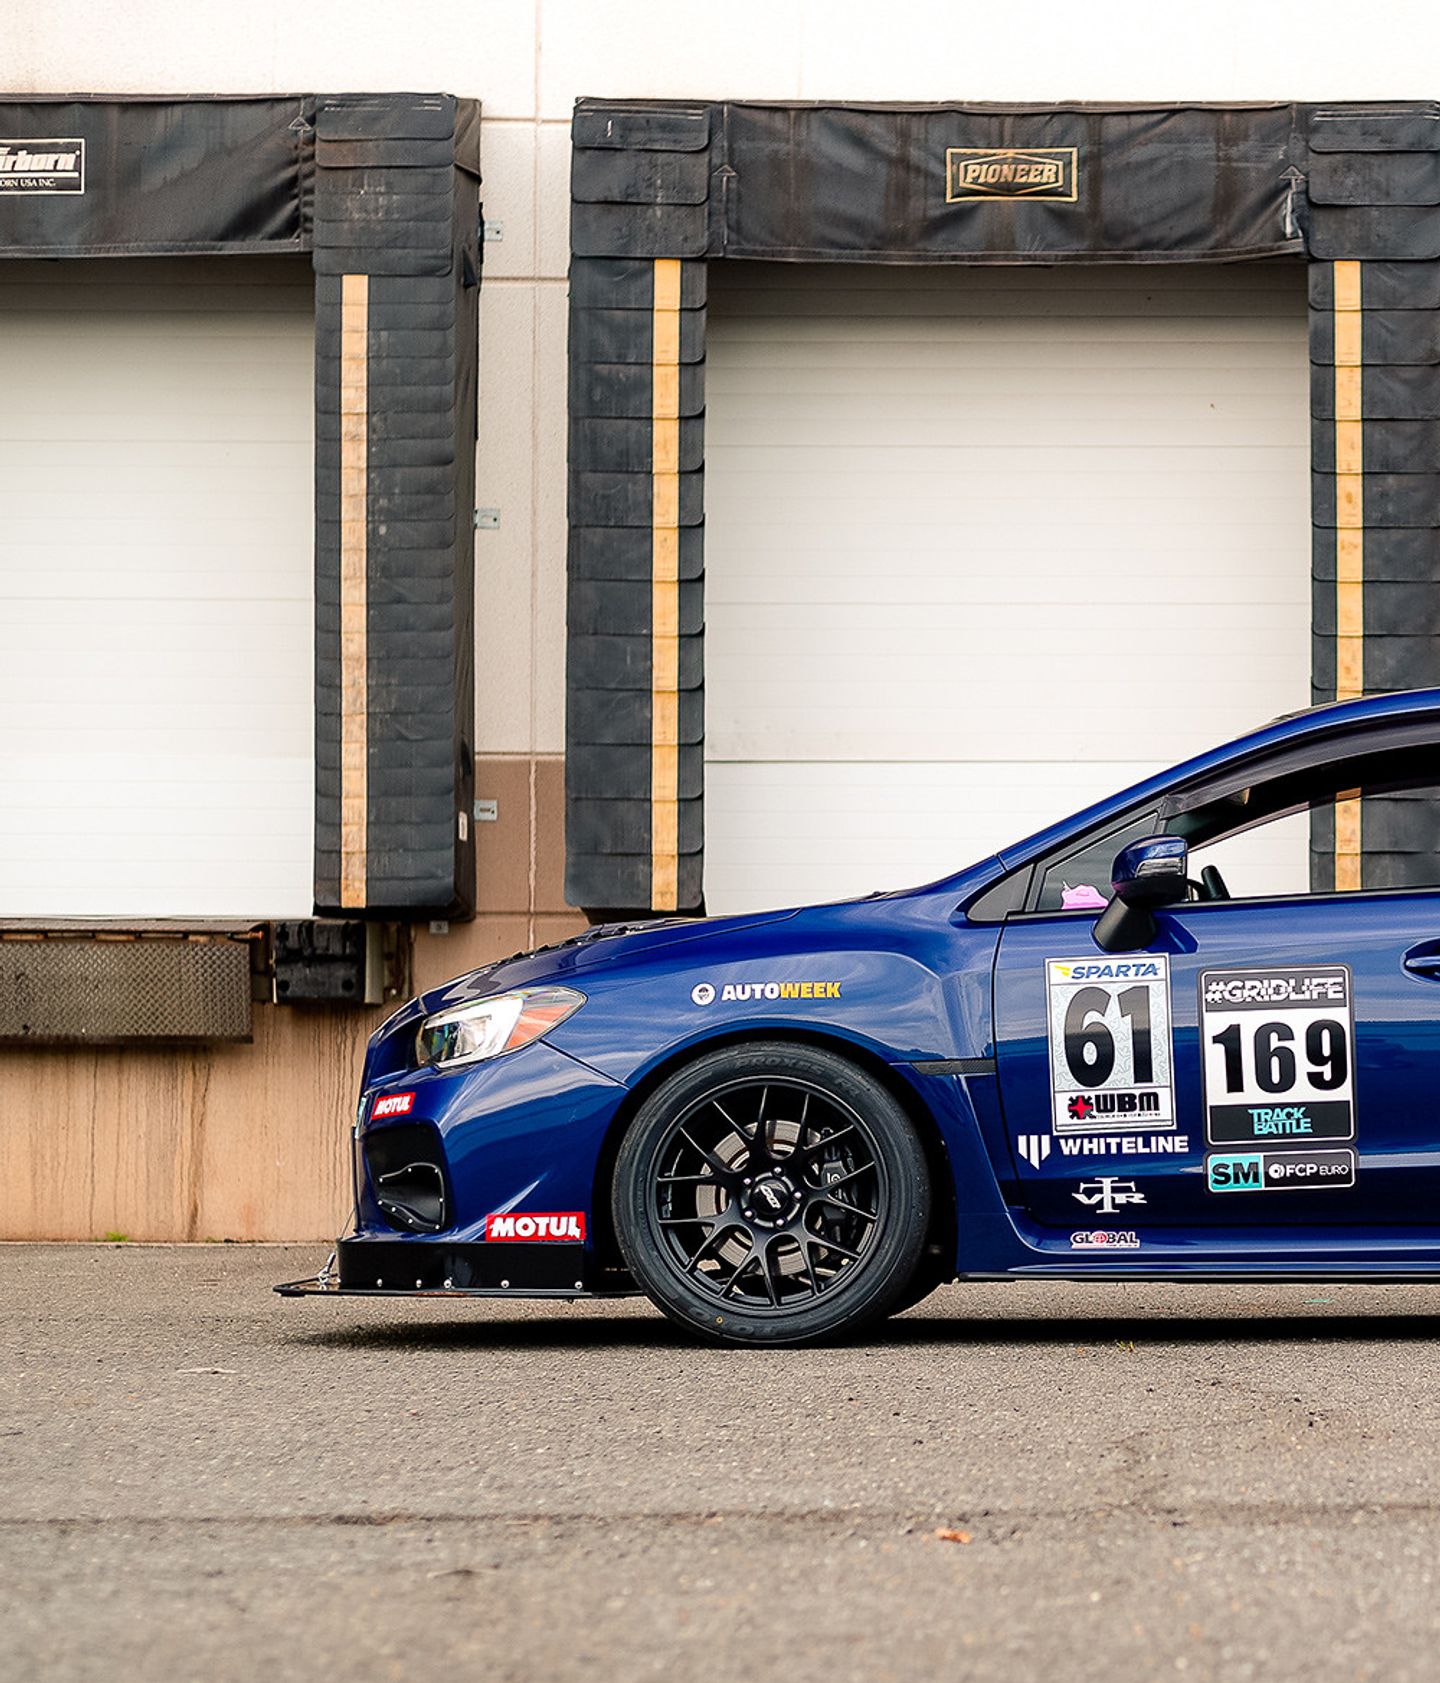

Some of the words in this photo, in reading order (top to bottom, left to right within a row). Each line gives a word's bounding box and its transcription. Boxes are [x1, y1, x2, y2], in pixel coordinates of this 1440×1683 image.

[20, 179, 38, 187] USA
[965, 164, 1057, 183] PIONEER
[1072, 964, 1158, 979] SPARTA
[722, 982, 841, 1000] AUTOWEEK
[1205, 977, 1344, 1003] #GRIDLIFE
[1064, 986, 1152, 1087] 61
[1212, 1019, 1348, 1094] 169
[374, 1095, 411, 1115] MOTUL
[1095, 1092, 1160, 1113] WBM
[1248, 1107, 1306, 1121] TRACK
[1254, 1118, 1313, 1134] BATTLE
[1060, 1135, 1189, 1155] WHITELINE
[1212, 1162, 1260, 1185] SM
[1286, 1164, 1318, 1177] FCP
[1320, 1165, 1349, 1176] EURO
[489, 1216, 581, 1238] MOTUL
[1072, 1231, 1138, 1244] GLOBAL
